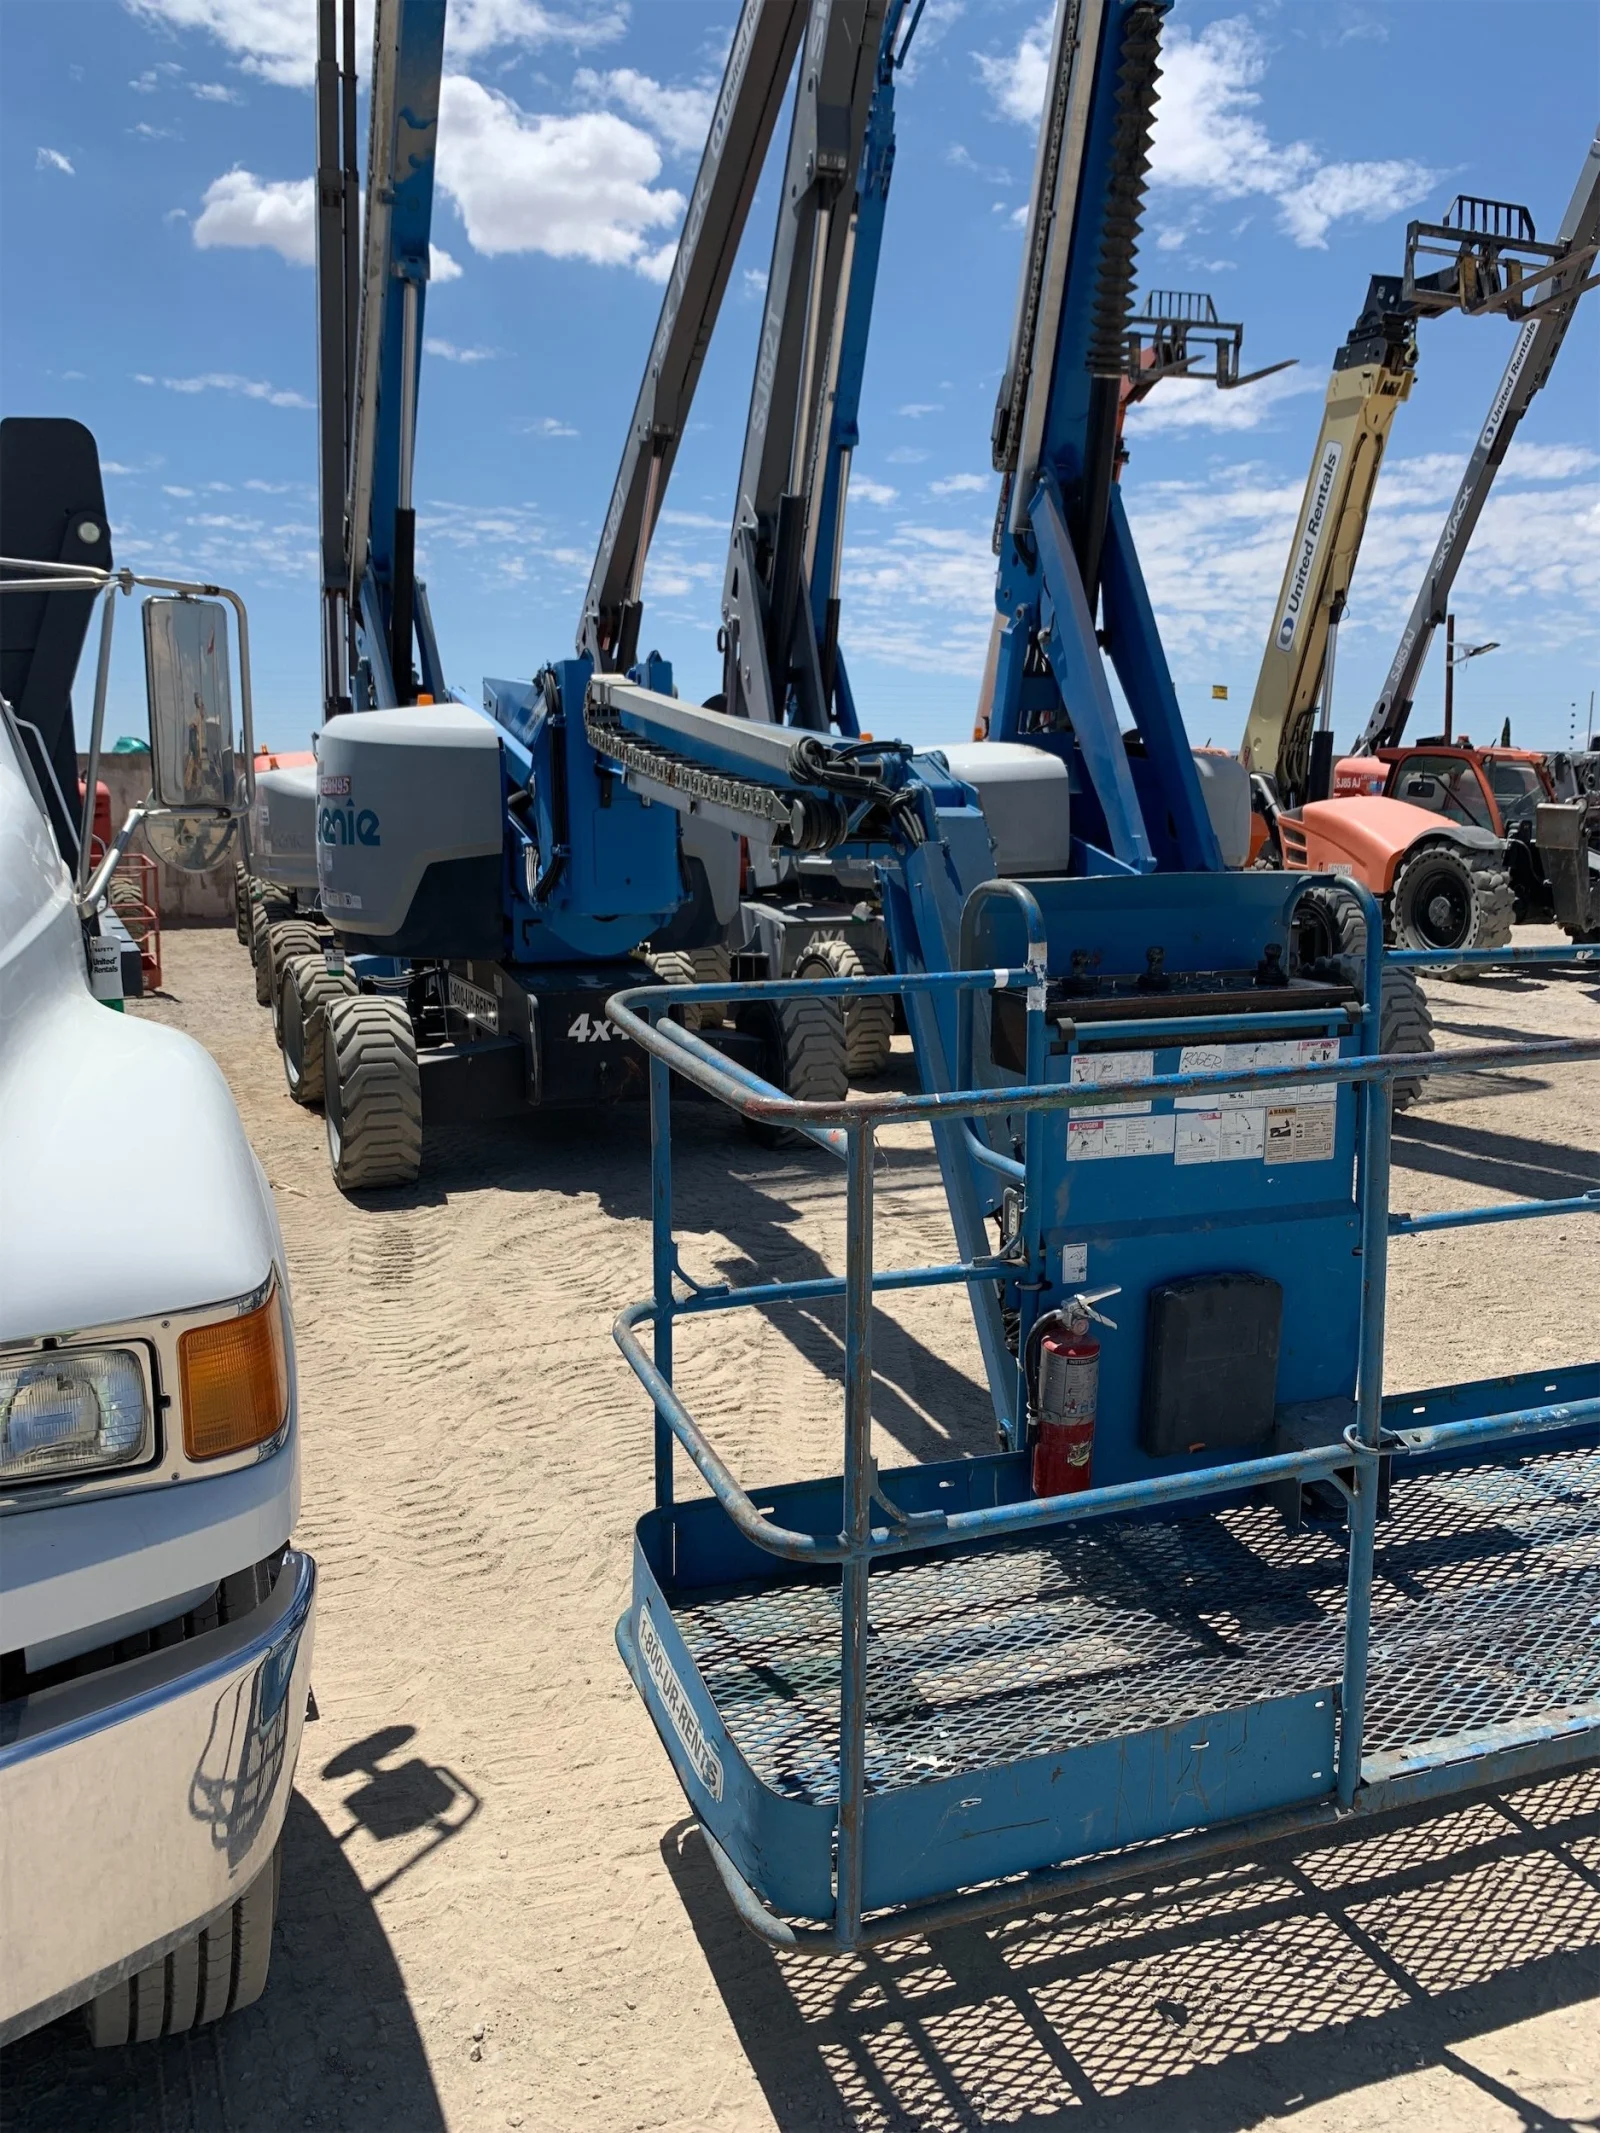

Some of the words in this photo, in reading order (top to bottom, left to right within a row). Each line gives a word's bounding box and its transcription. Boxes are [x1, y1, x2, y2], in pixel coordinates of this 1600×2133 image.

[752, 300, 780, 434] SJ82T
[1492, 378, 1513, 424] United
[1511, 321, 1536, 376] Rentals
[1288, 541, 1314, 613] United
[1308, 452, 1337, 536] Rentals
[1435, 485, 1473, 572] SKYJACK
[1390, 648, 1409, 682] SJ85
[94, 957, 115, 966] United
[1182, 1051, 1222, 1068] ROGER
[640, 1619, 718, 1787] 1-800-UR-RENTS
